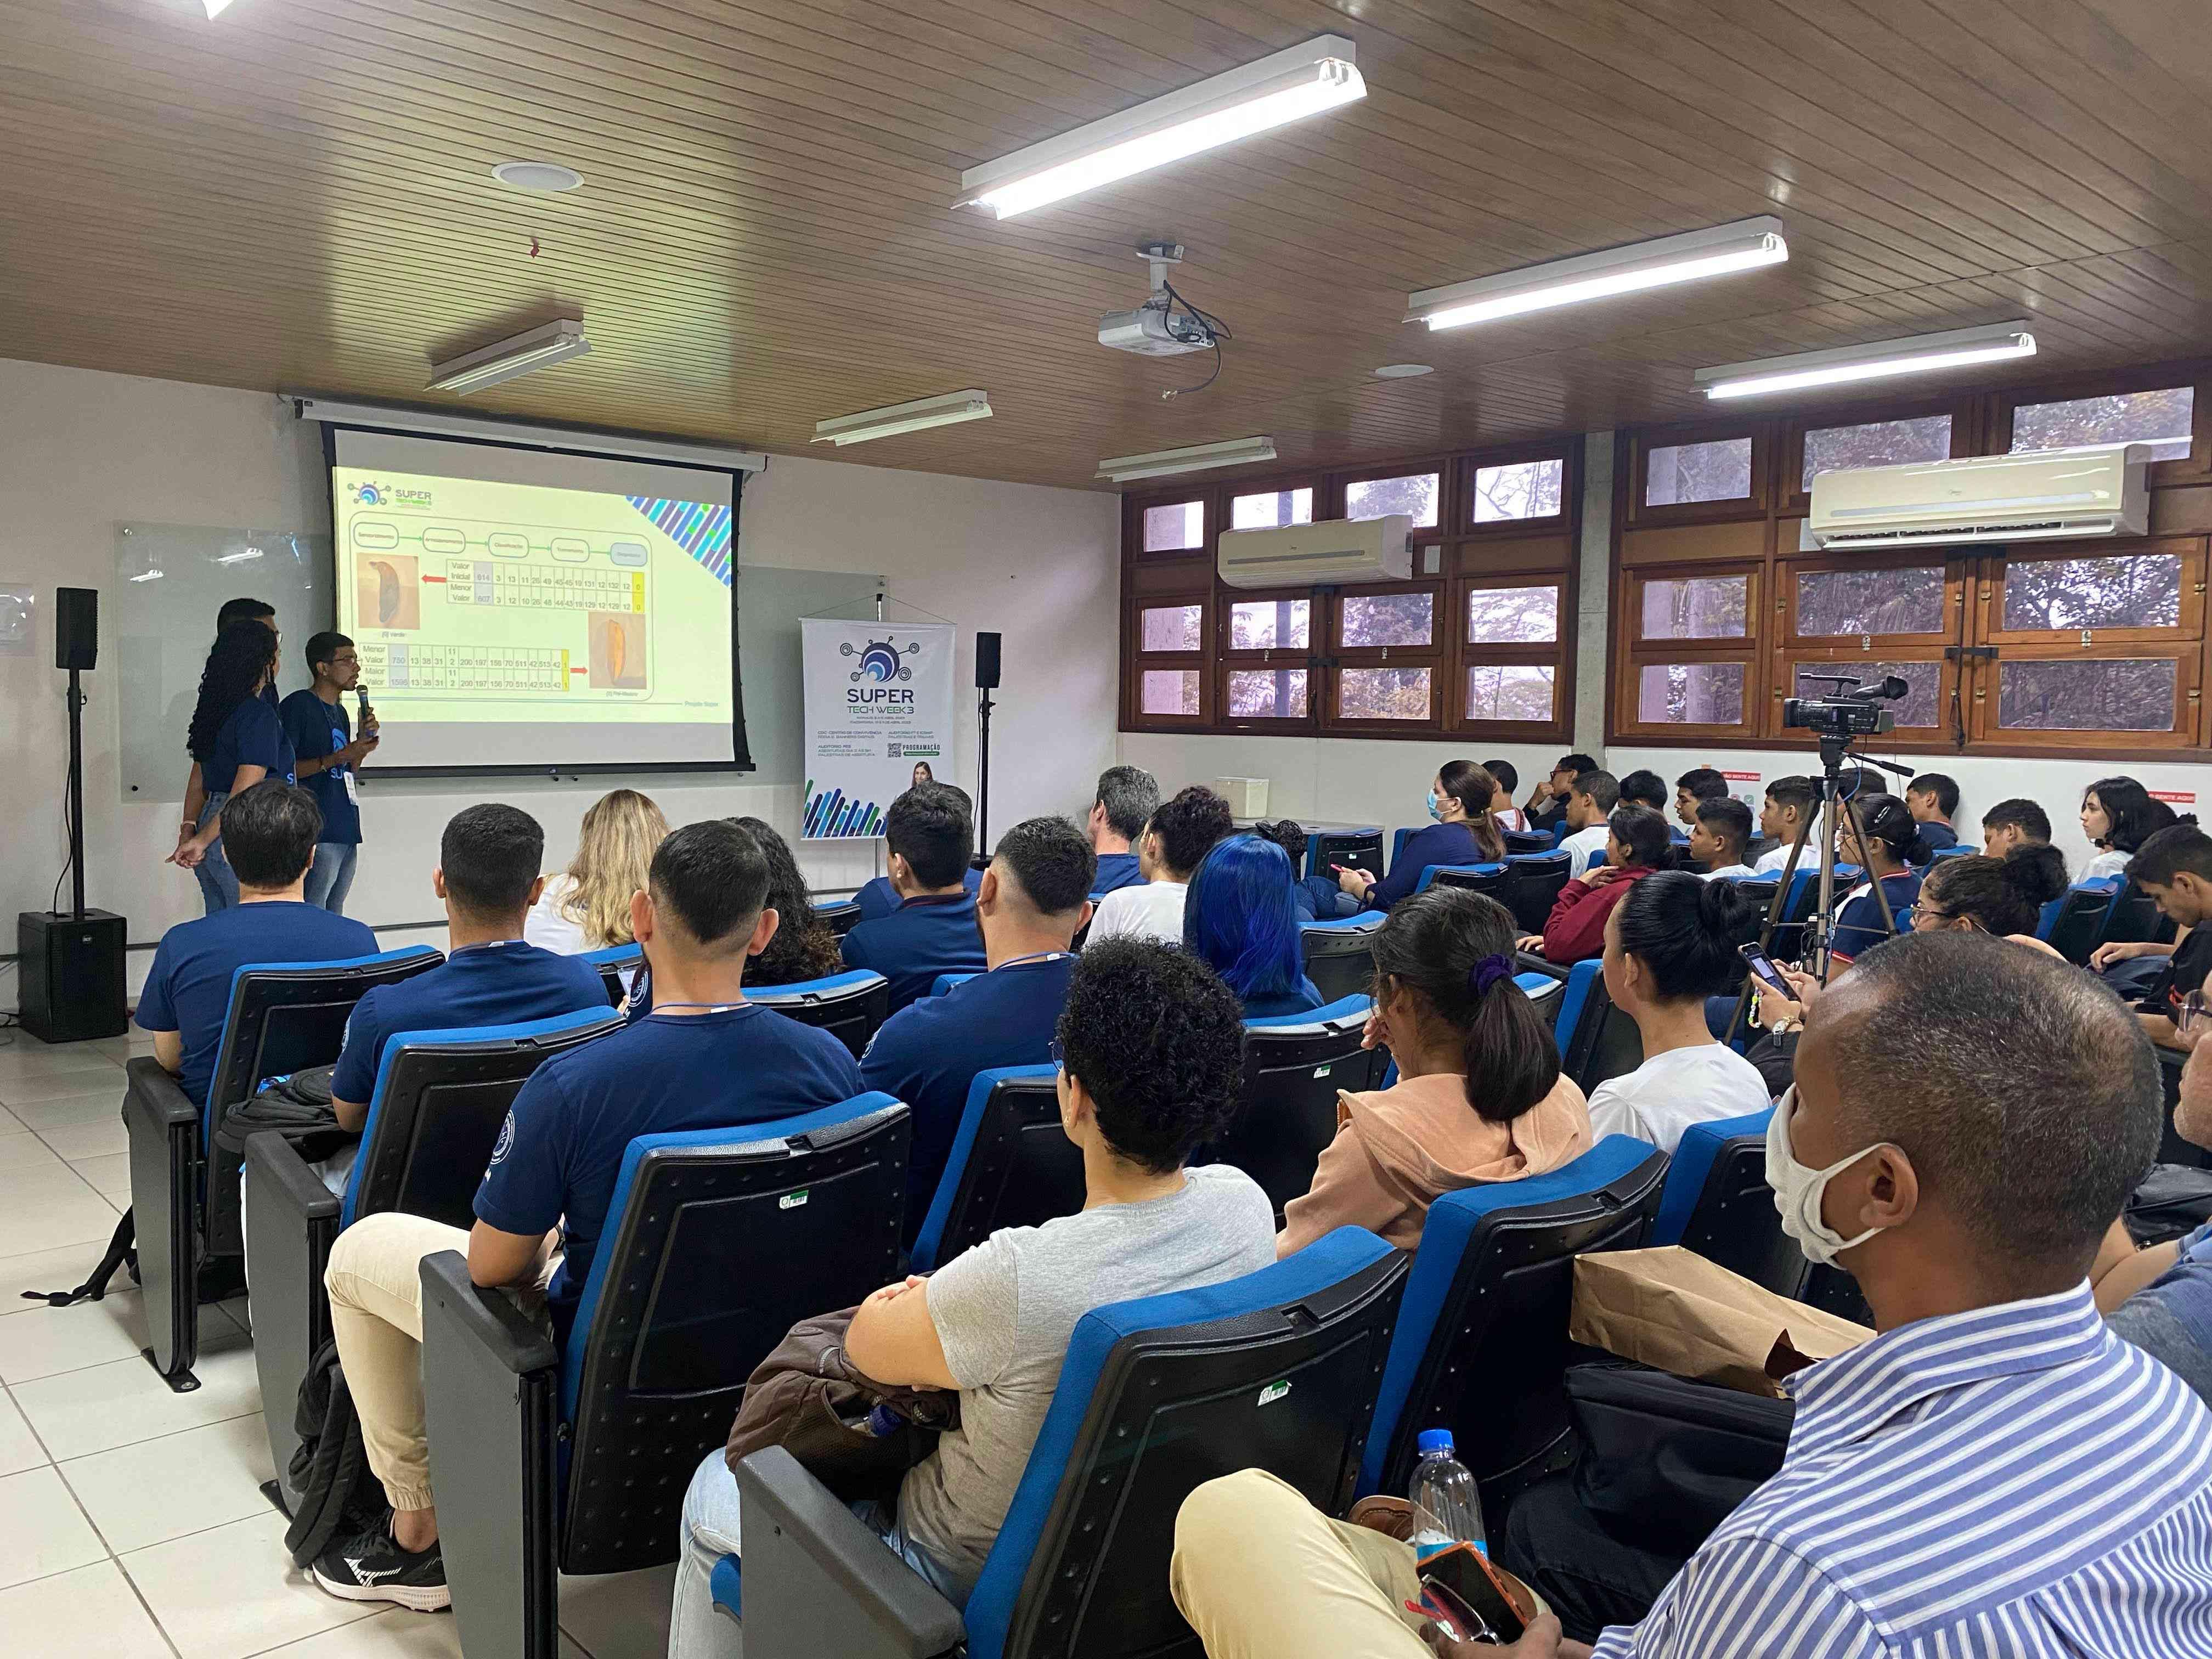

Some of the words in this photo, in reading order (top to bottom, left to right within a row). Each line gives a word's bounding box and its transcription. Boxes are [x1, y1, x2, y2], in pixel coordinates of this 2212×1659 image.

[396, 489, 431, 500] SUPER
[847, 689, 914, 703] SUPER
[902, 743, 941, 752] PROGRAMAÇÃO
